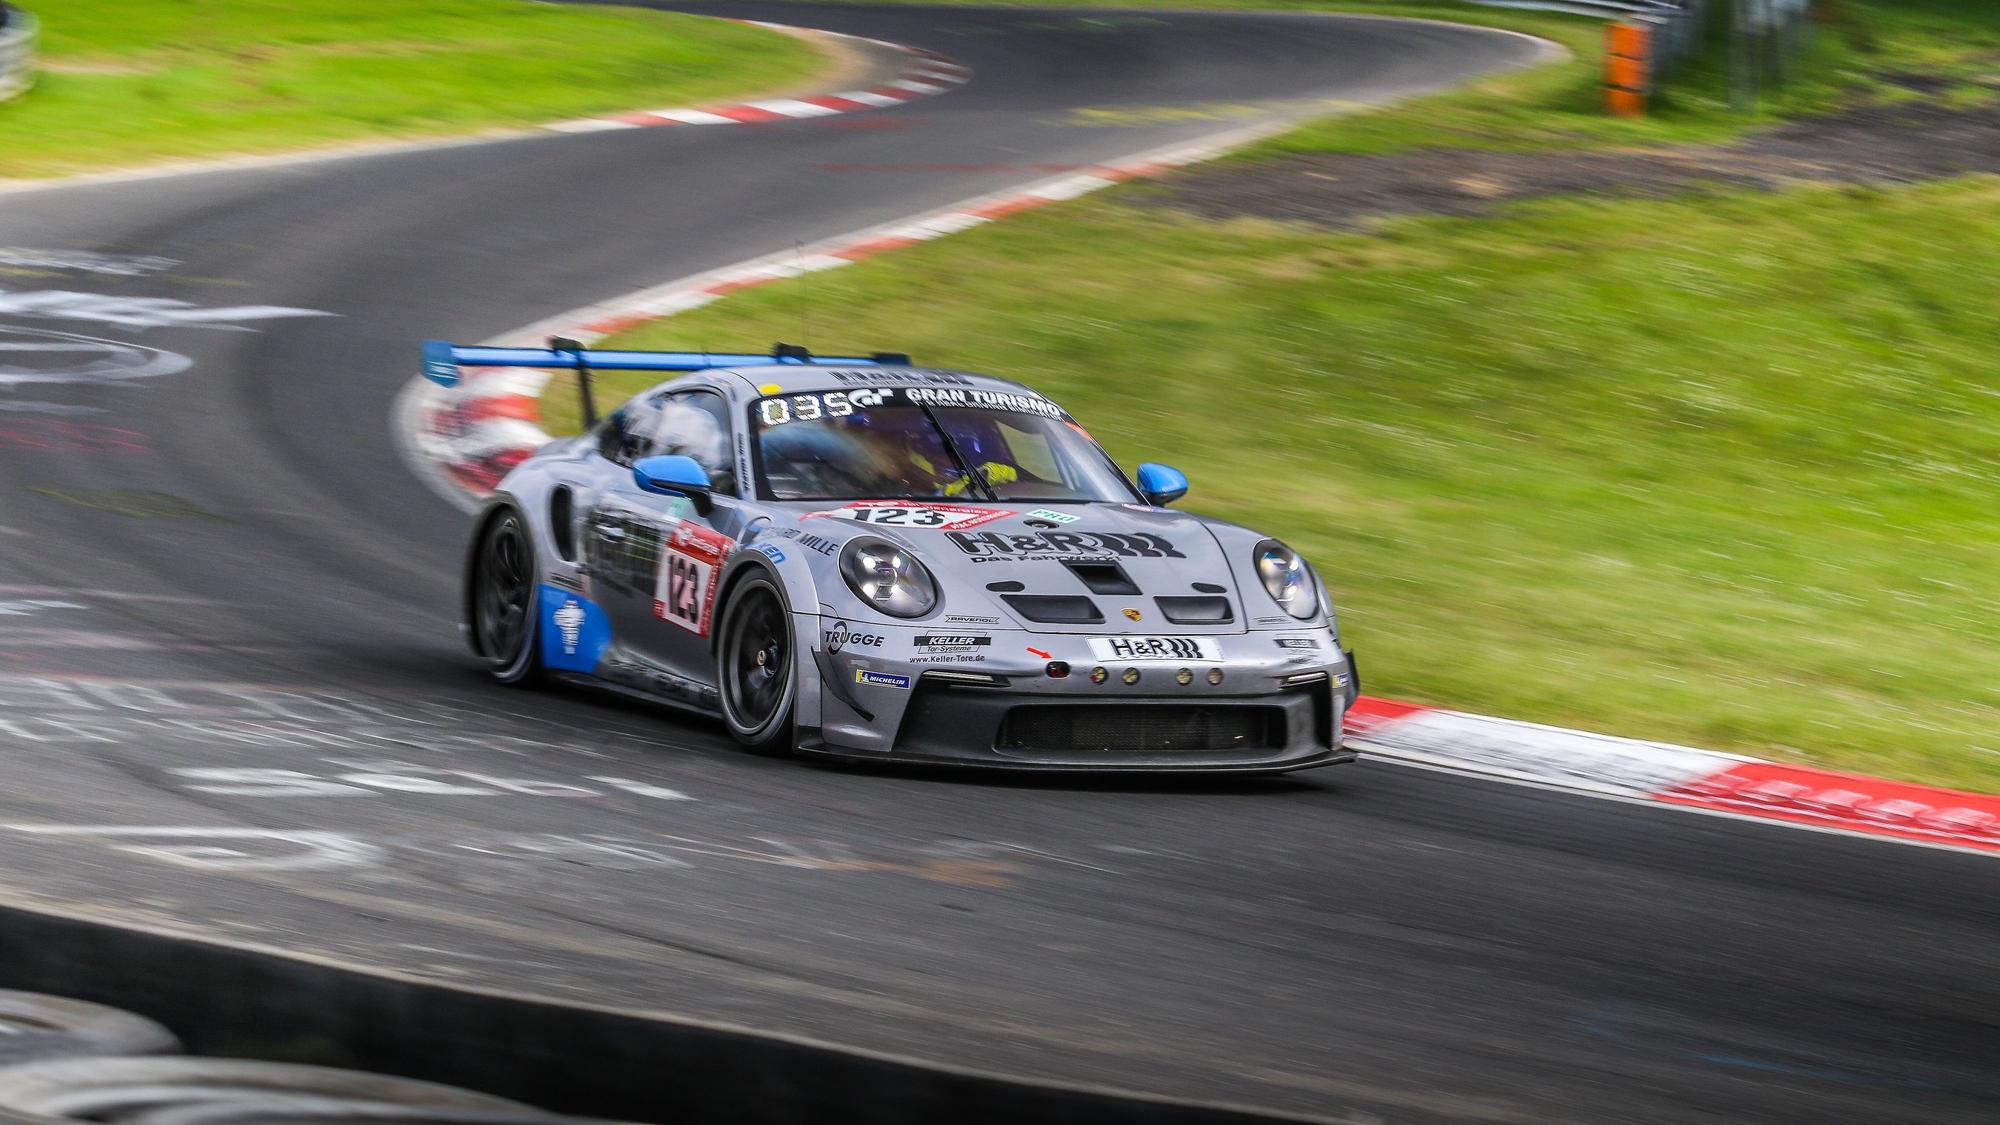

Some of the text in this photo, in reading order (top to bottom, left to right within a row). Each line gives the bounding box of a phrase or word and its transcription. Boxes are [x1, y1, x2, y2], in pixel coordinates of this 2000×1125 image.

[905, 388, 966, 404] GRAN
[968, 390, 1062, 418] TURISMO
[854, 508, 946, 526] 123
[945, 531, 1119, 557] H&R
[669, 554, 698, 624] 123
[825, 630, 885, 648] TRUGGE
[928, 636, 976, 645] KELLER
[1108, 638, 1170, 657] H&R
[927, 645, 972, 653] Tor-Systeme
[909, 654, 985, 664] www.Keller-Tore.de
[869, 675, 906, 686] MICHELIN
